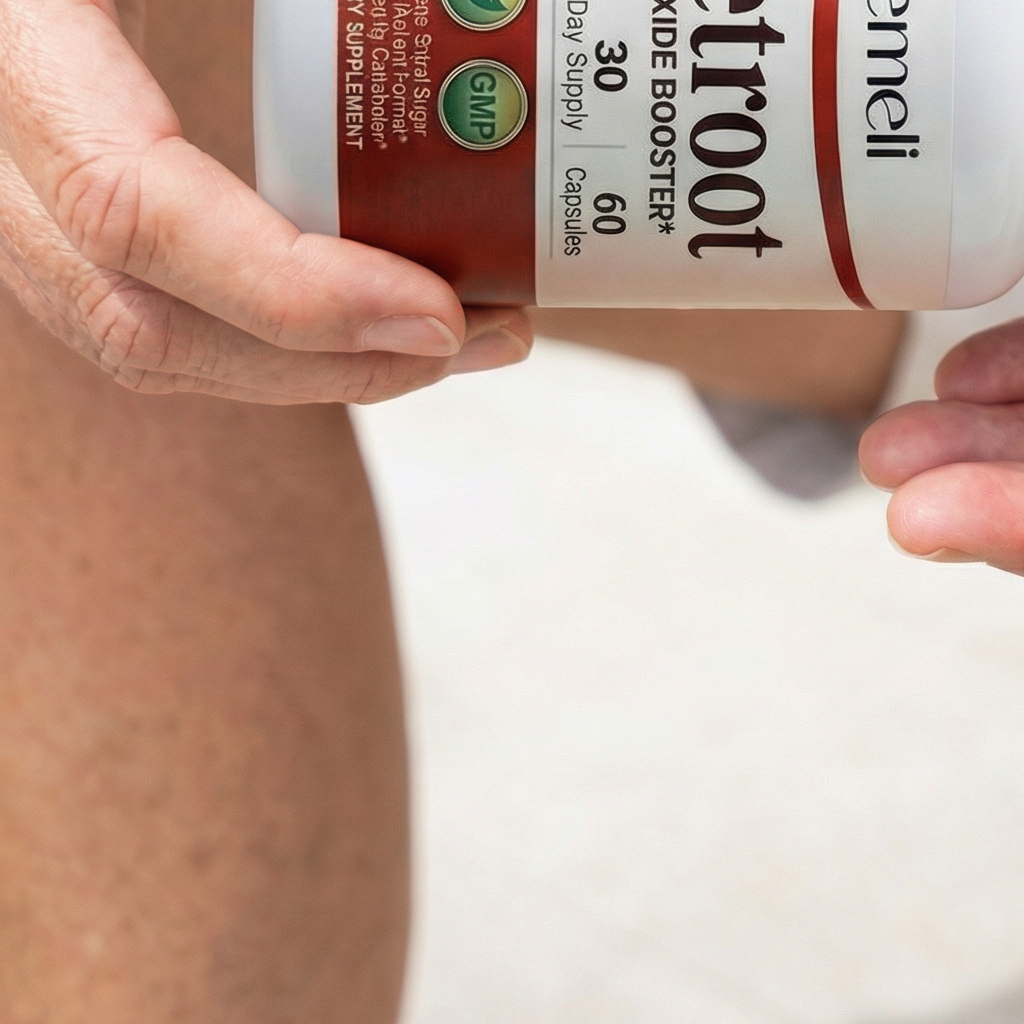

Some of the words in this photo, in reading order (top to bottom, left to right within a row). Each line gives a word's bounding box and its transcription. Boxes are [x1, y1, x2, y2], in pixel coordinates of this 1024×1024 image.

[562, 0, 588, 43] Day
[345, 22, 365, 150] SUPPLEMENT
[560, 53, 587, 131] Supply
[593, 40, 628, 92] 30
[469, 74, 497, 139] GMP
[559, 167, 586, 256] Capsules
[592, 192, 627, 235] 60
